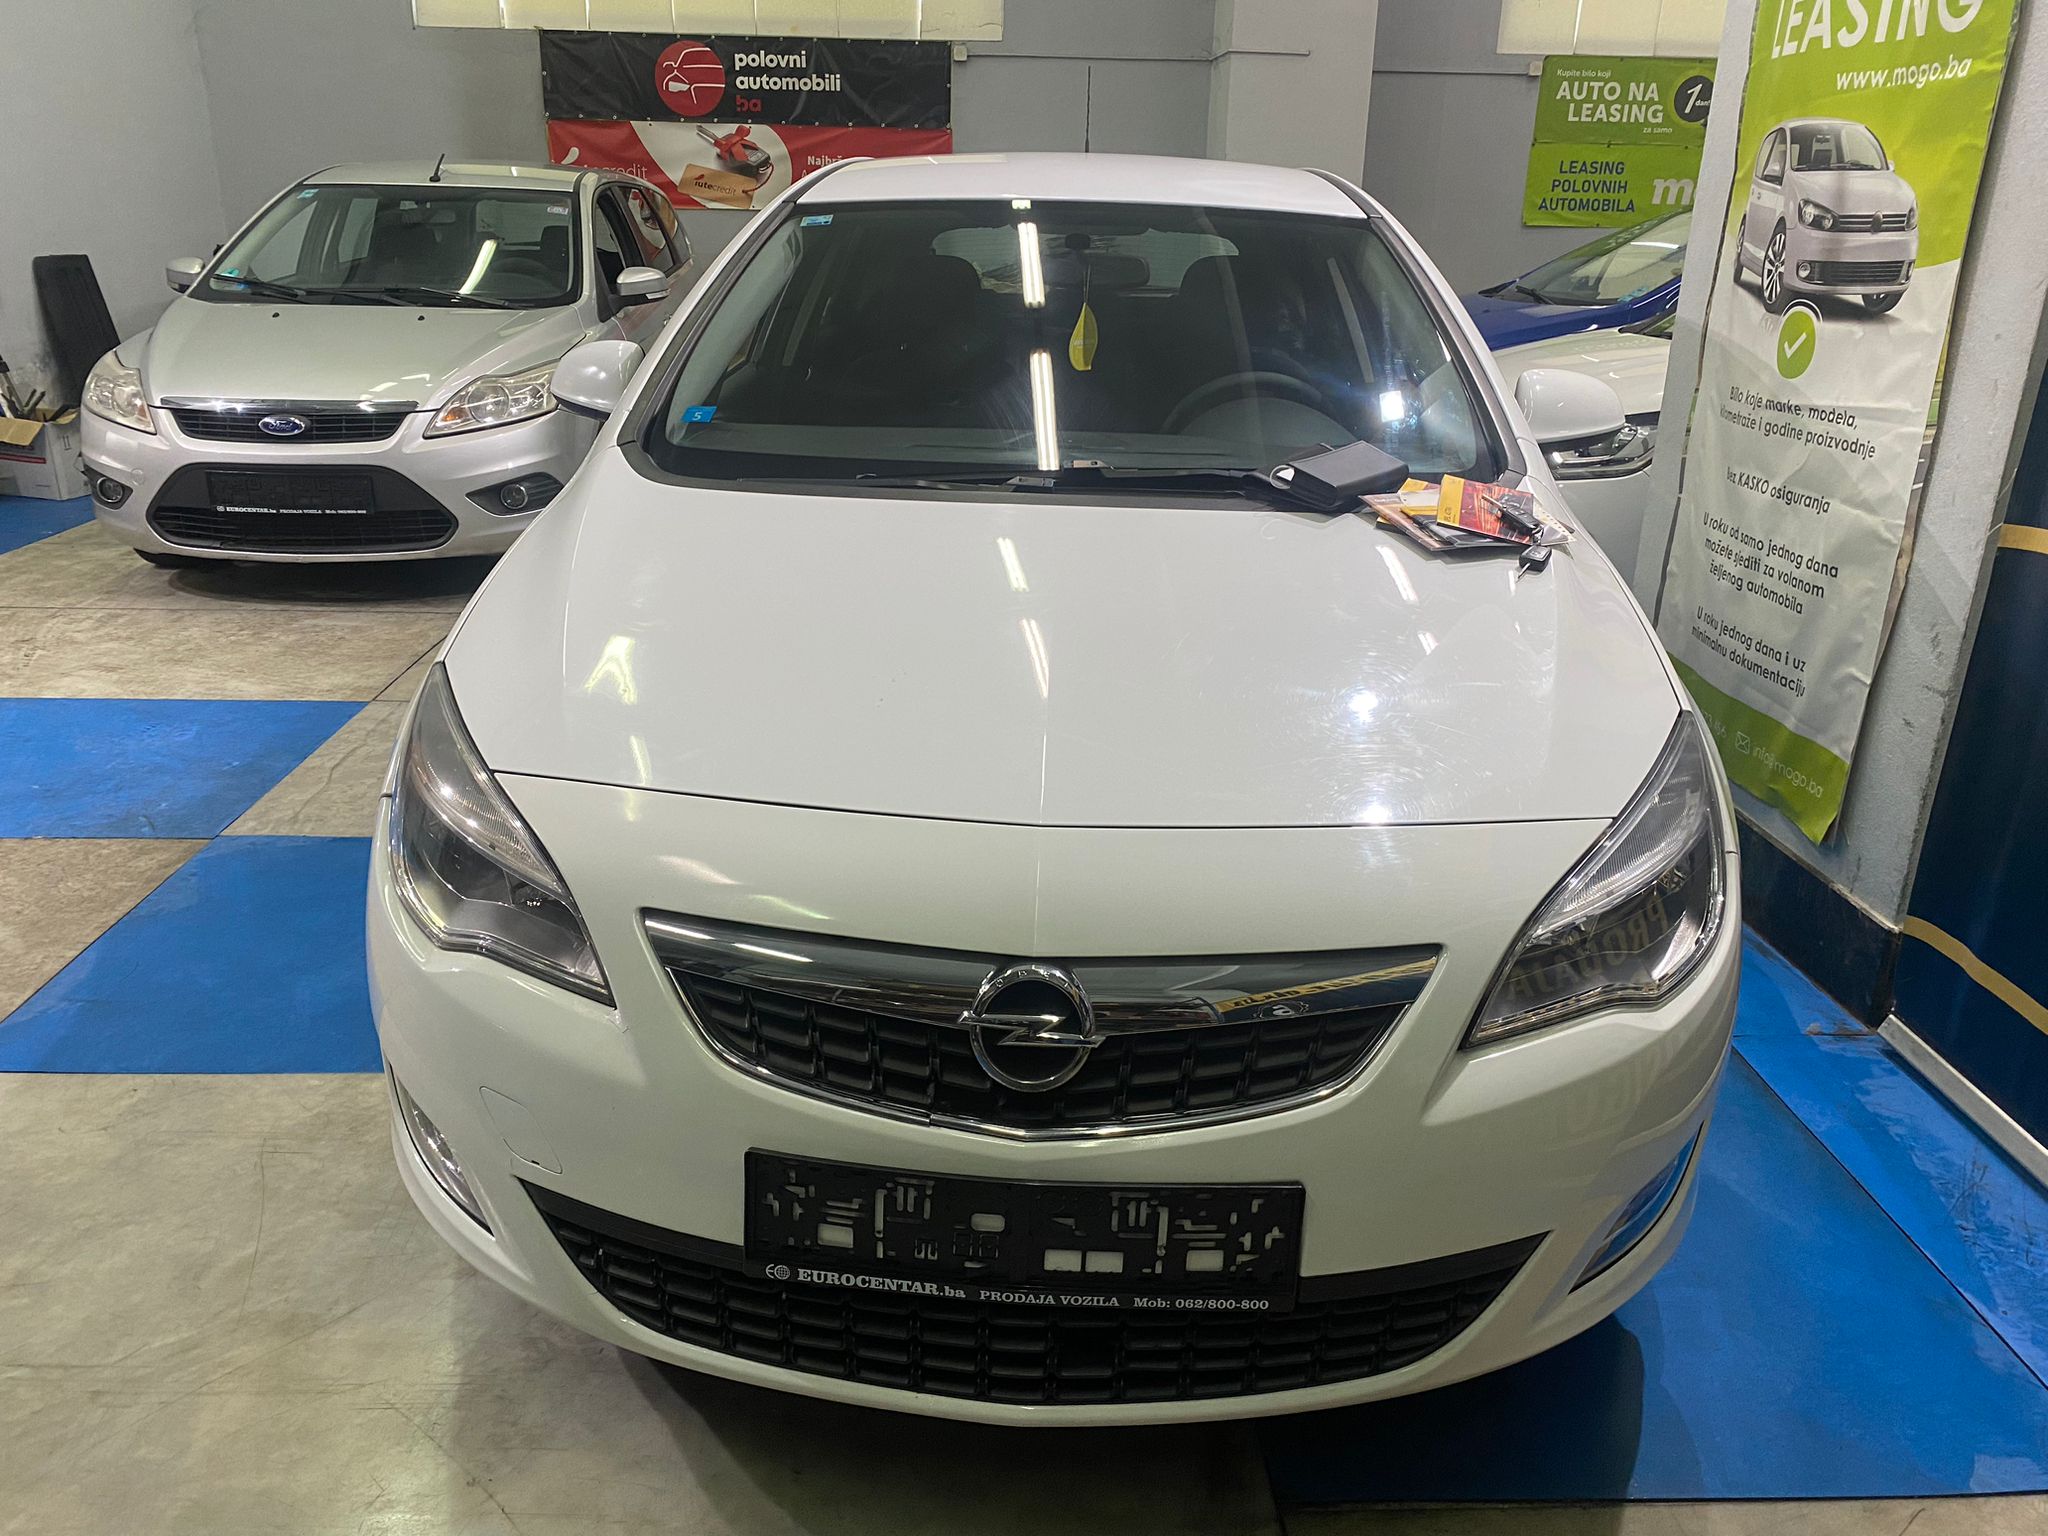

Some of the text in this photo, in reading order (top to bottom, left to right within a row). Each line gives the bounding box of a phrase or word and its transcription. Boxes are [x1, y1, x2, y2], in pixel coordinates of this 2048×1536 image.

[734, 50, 807, 71] polovni
[1557, 68, 1612, 79] Kupite bilo koji
[1836, 54, 1973, 90] www.mogo.ba
[735, 73, 841, 92] automobili
[1556, 81, 1659, 102] AUTO NA
[1568, 103, 1664, 123] LEASING
[1684, 83, 1703, 114] 1
[807, 155, 843, 167] Najb
[1559, 160, 1625, 175] LEASING
[1551, 179, 1628, 194] POLOVNIH
[1538, 197, 1636, 213] AUTOMOBILA
[693, 412, 702, 421] 5
[1745, 390, 1763, 411] koje
[1765, 400, 1805, 419] marke,
[1808, 407, 1858, 431] modela,
[1758, 416, 1763, 431] i
[1764, 421, 1803, 441] godine
[1804, 431, 1876, 461] proizvodnje
[1737, 471, 1769, 495] KASKO
[1770, 485, 1831, 515] osiguranja
[1703, 511, 1839, 578] U roku od samo jednog dana
[1705, 538, 1825, 598] možete sjediti za volanom
[1709, 559, 1803, 615] željenog automobila
[1697, 605, 1807, 673] U roku jednog dana i uz
[1691, 625, 1806, 698] minimalnu dokumentaciju
[797, 1267, 1270, 1310] EUROCENTAR.ba PRODAJA VOZILA Mob: 062/800-800
